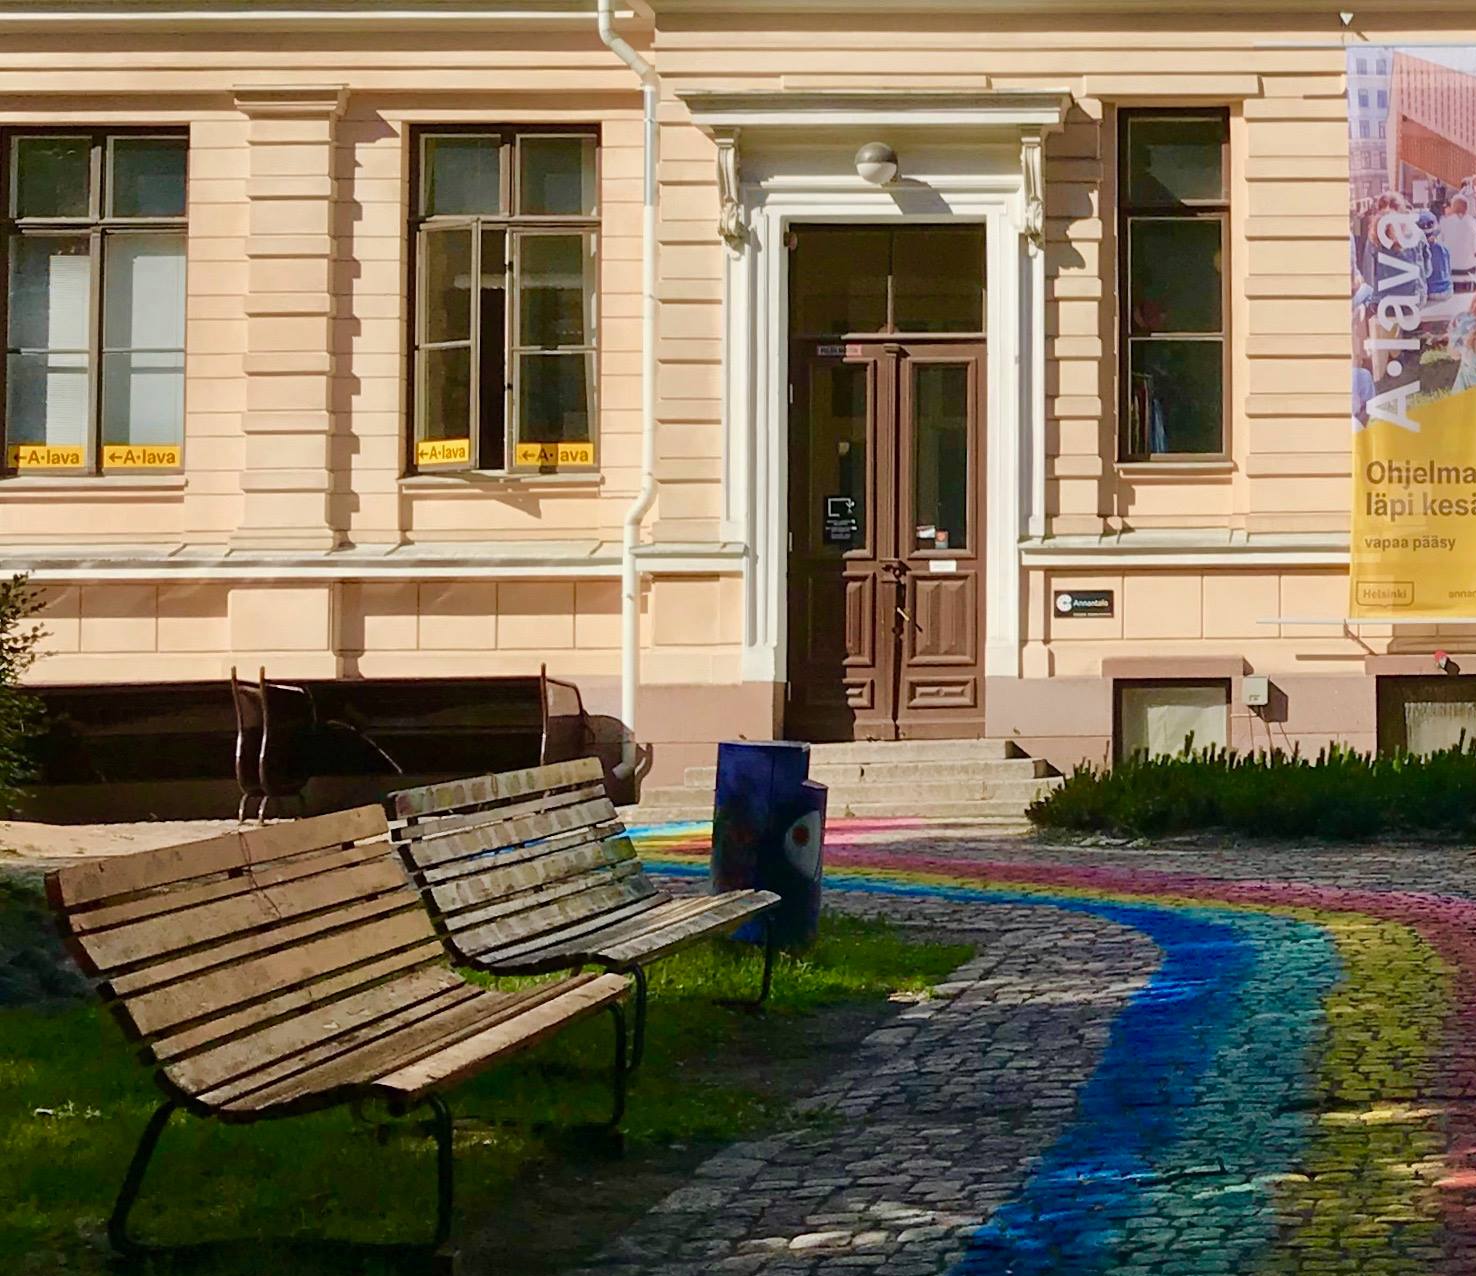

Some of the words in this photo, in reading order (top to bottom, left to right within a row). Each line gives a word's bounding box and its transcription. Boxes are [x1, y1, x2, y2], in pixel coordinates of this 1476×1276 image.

[1366, 492, 1414, 522] läpi
[1365, 537, 1409, 551] vapaa
[1413, 535, 1456, 551] pääsy
[1363, 588, 1407, 600] Helsinki
